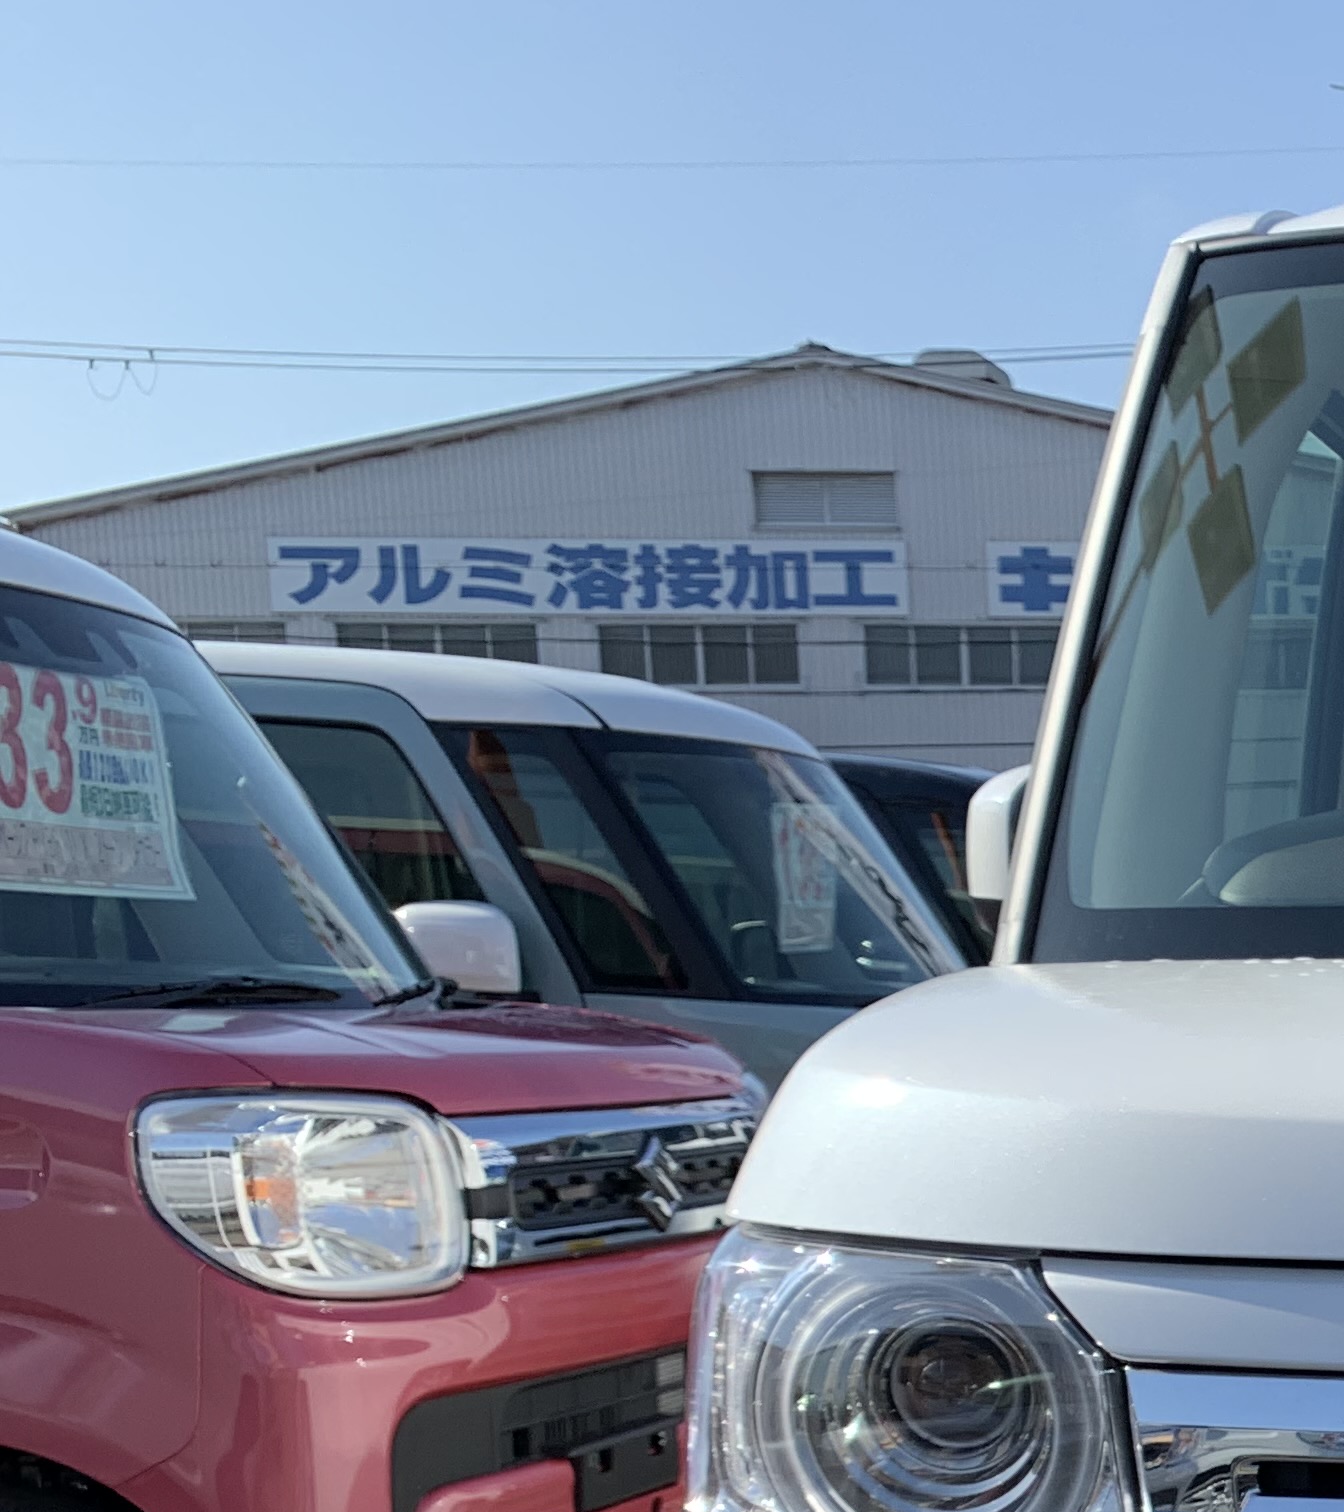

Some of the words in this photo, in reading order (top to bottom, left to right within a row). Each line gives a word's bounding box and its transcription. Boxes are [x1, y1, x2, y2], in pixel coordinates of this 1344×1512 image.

[277, 542, 898, 610] アルミ溶接加工
